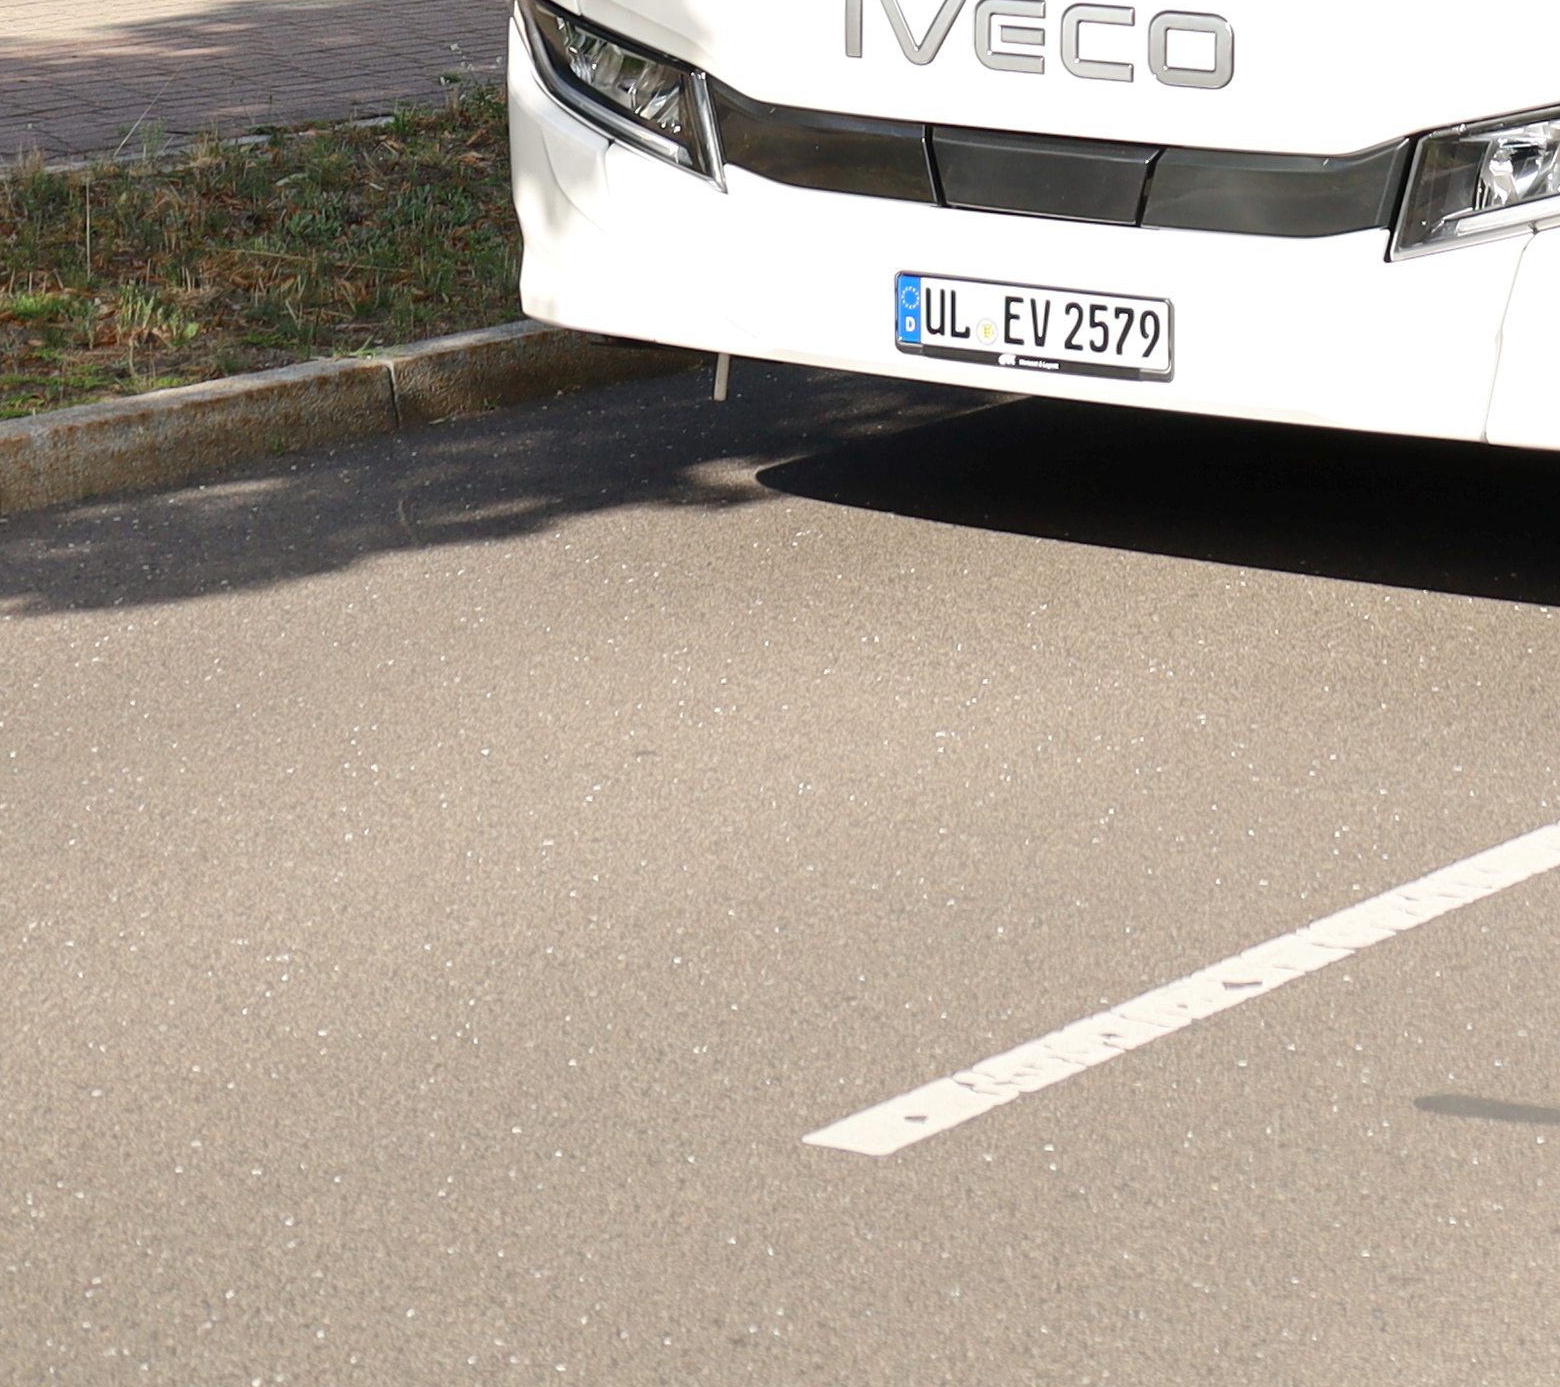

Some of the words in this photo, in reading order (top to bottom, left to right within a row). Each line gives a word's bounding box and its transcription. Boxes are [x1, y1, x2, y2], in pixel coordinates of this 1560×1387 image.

[905, 316, 916, 332] D
[925, 287, 971, 339] UL
[1003, 296, 1052, 349] EV
[1064, 302, 1161, 358] 2579
